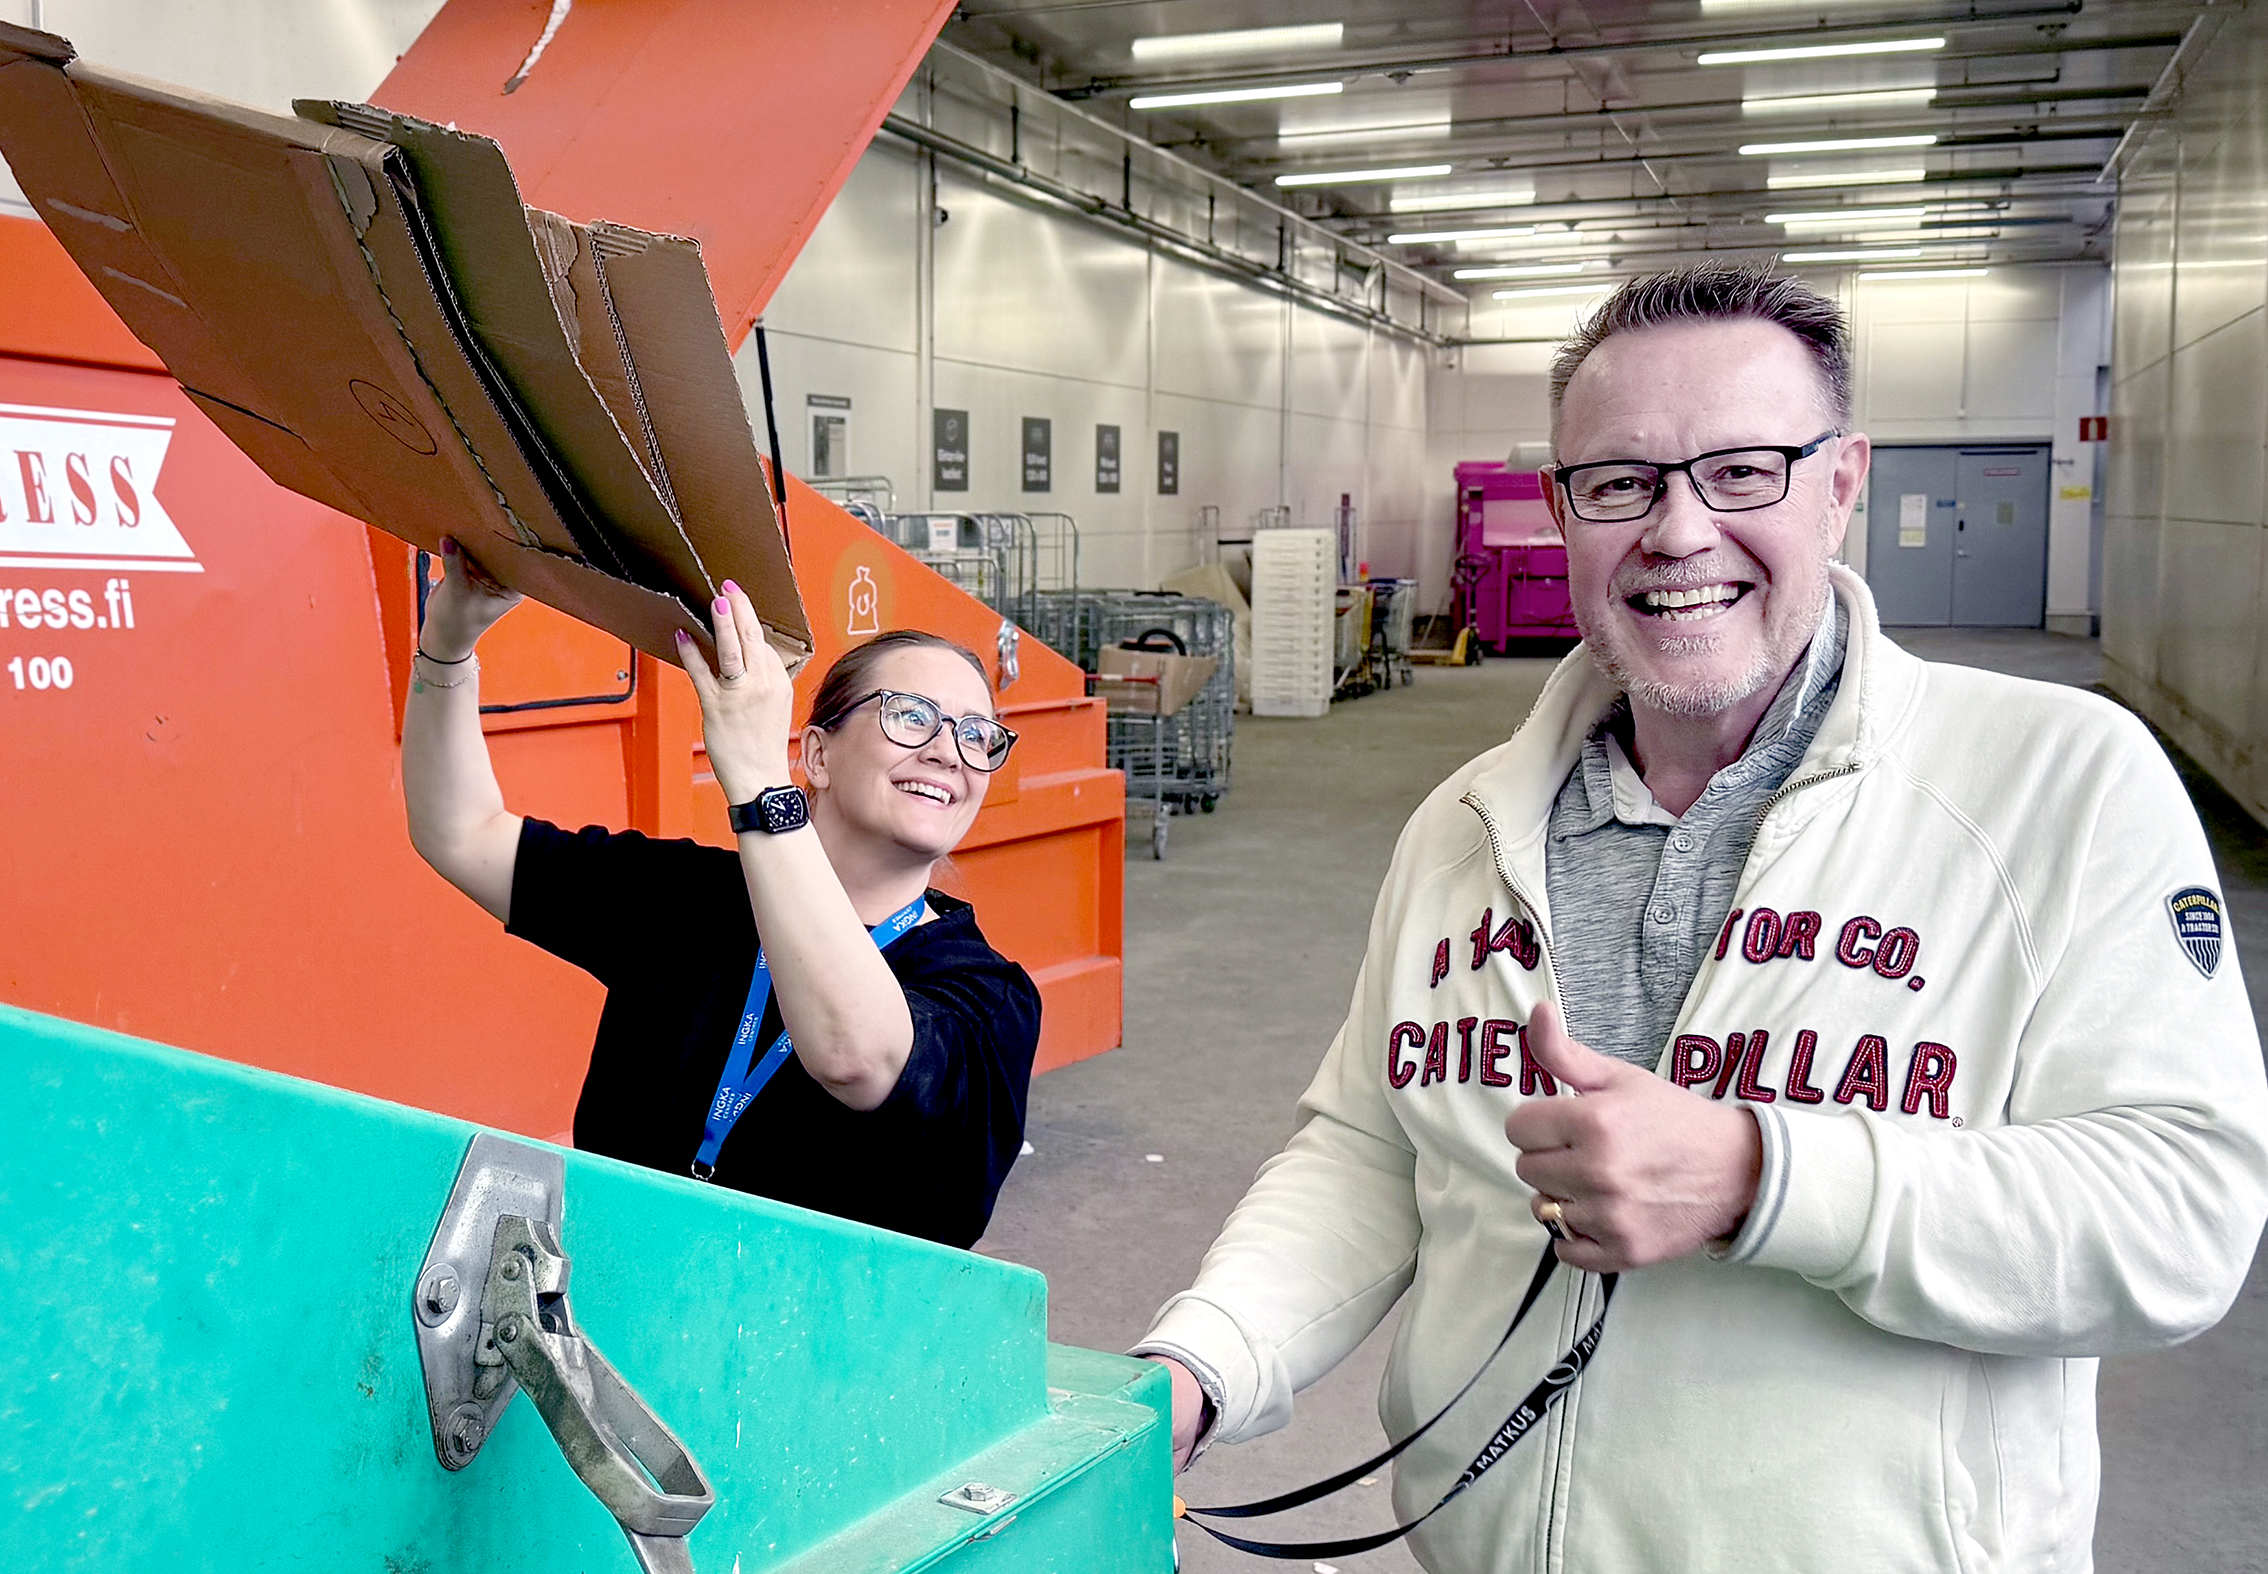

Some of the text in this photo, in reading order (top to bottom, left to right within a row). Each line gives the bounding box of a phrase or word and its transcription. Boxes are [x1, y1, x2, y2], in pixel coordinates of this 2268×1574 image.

[0, 449, 141, 529] ESS
[7, 655, 74, 690] 100
[1835, 915, 1926, 993] CO.
[737, 1012, 755, 1045] INGKA
[711, 1086, 732, 1121] INGKA
[1476, 1405, 1536, 1470] MATKUS
